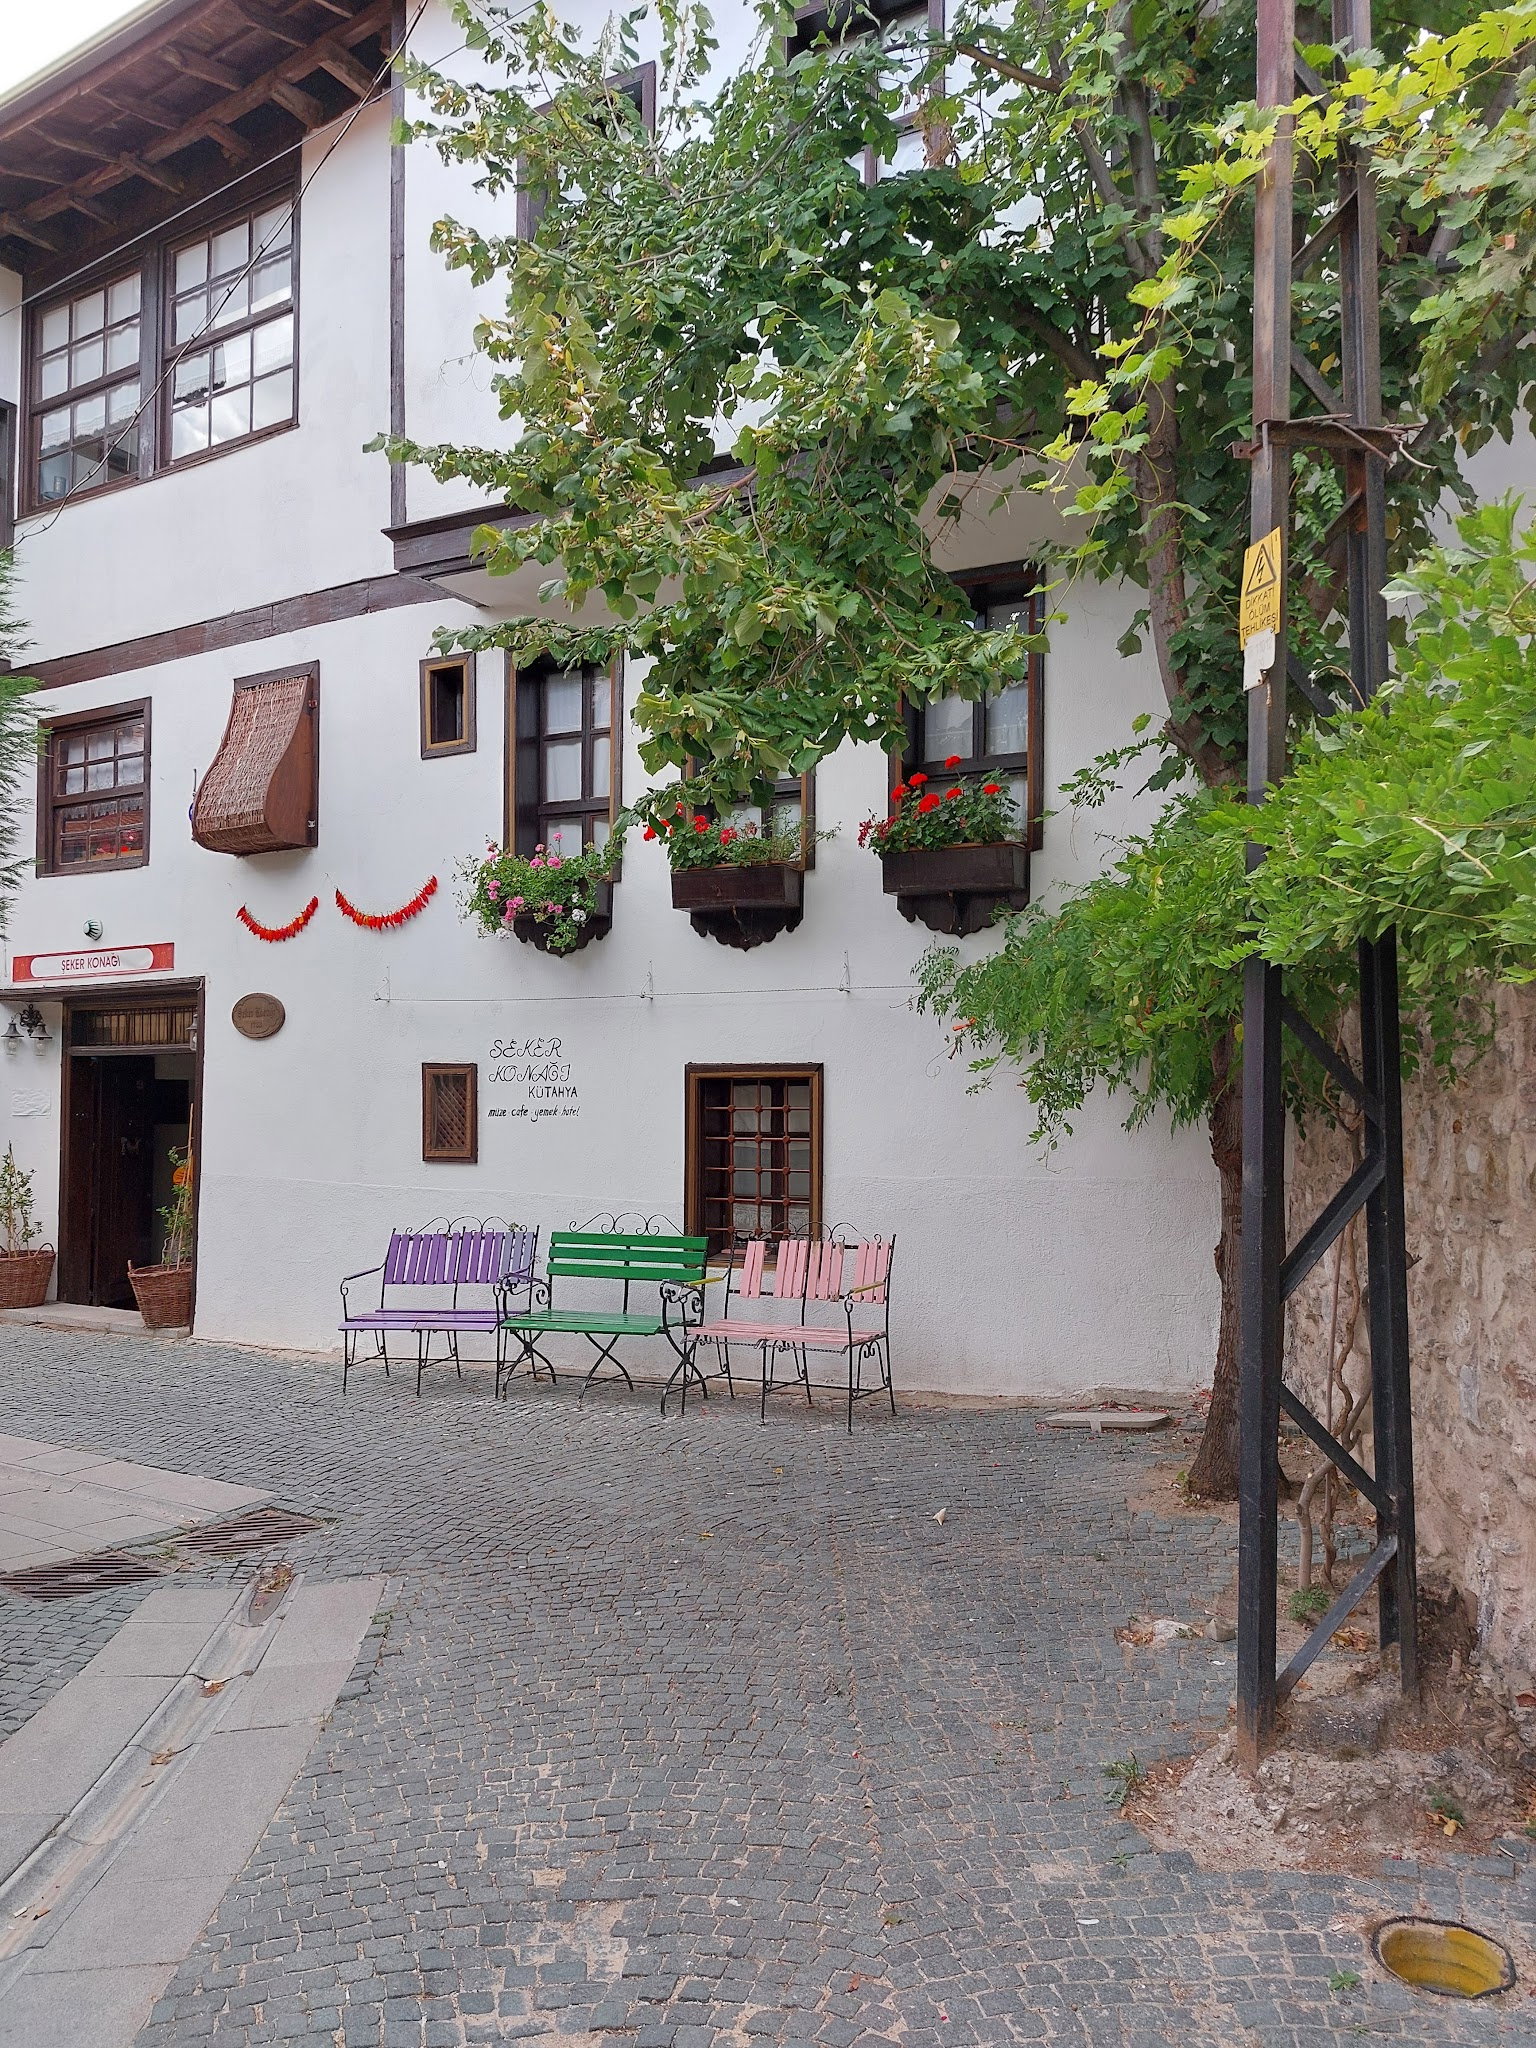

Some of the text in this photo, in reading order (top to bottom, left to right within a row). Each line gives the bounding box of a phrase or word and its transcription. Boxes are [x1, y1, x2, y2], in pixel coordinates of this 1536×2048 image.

[61, 952, 121, 974] ŞEKER KONAĞI
[488, 1061, 571, 1082] KONAĞI
[528, 1085, 578, 1098] KÜTAHYA
[511, 1104, 528, 1118] cafe
[531, 1105, 559, 1122] yemek
